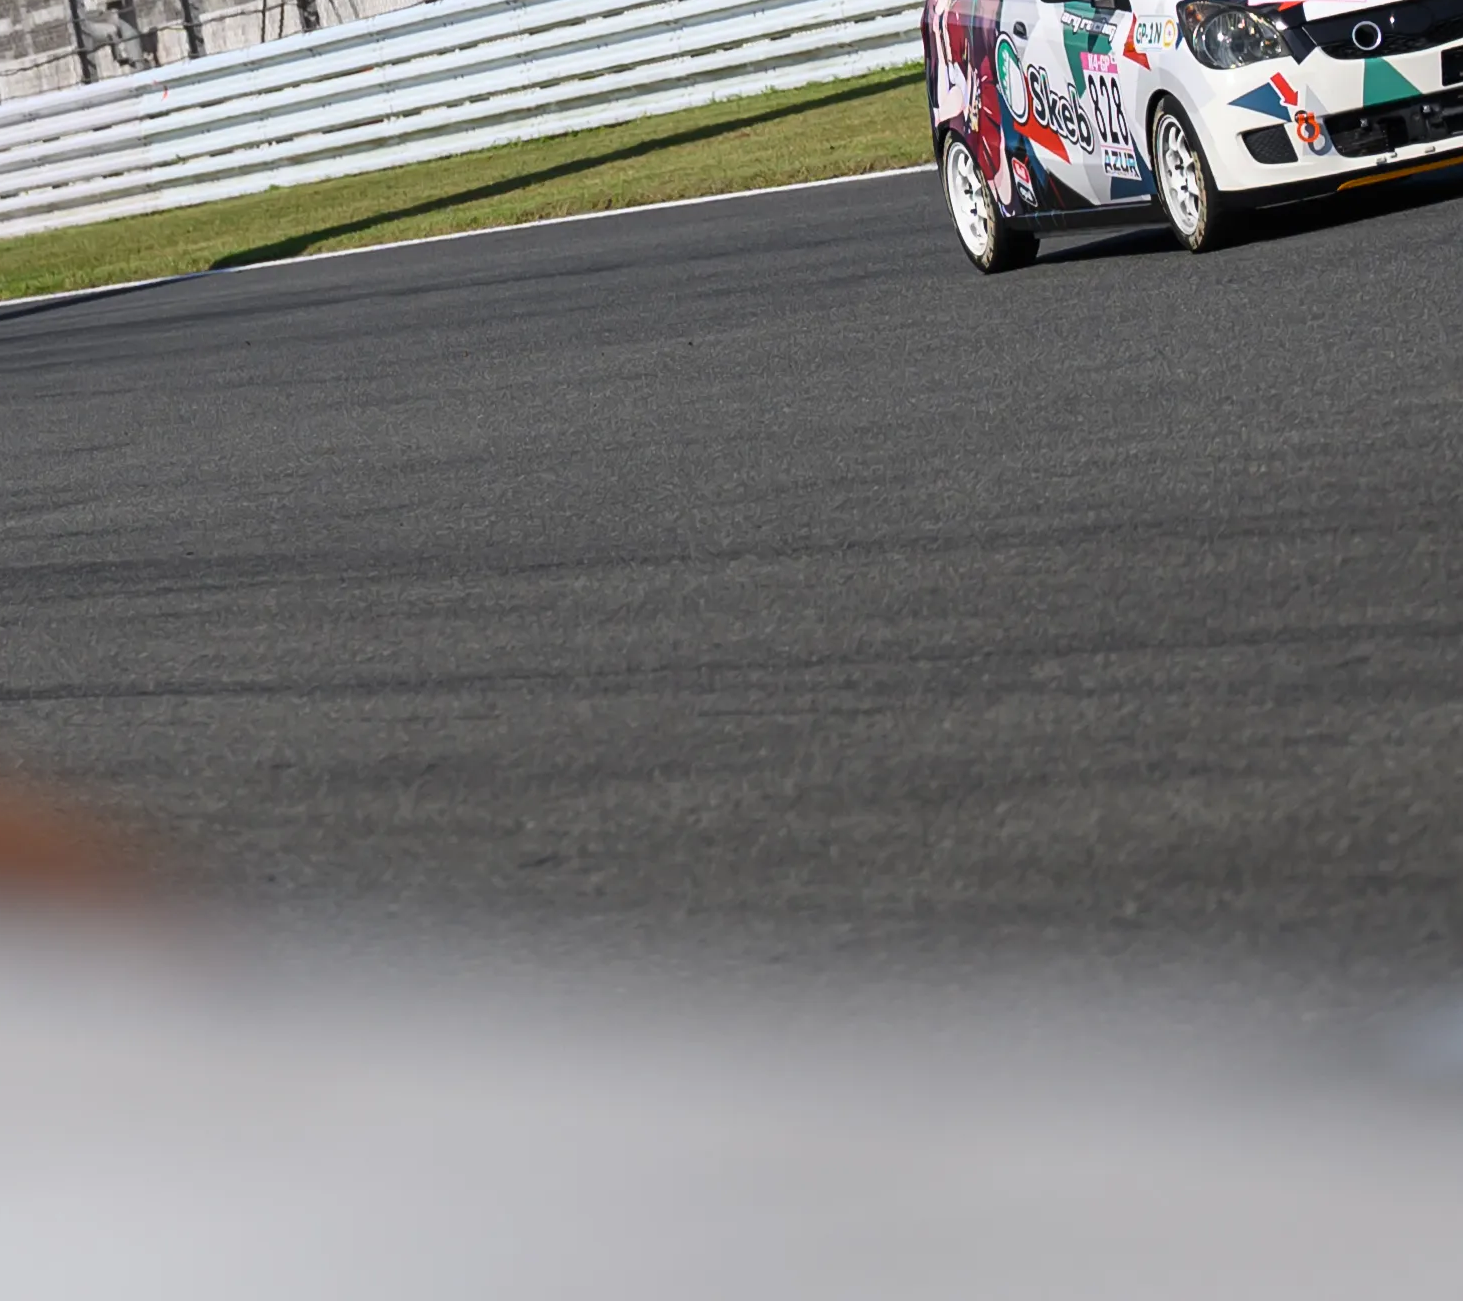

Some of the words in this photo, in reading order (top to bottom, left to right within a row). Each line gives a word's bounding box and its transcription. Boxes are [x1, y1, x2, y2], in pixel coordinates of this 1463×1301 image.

[1026, 63, 1095, 155] Skeb
[1087, 74, 1132, 145] 828
[1104, 149, 1140, 178] AZUR
